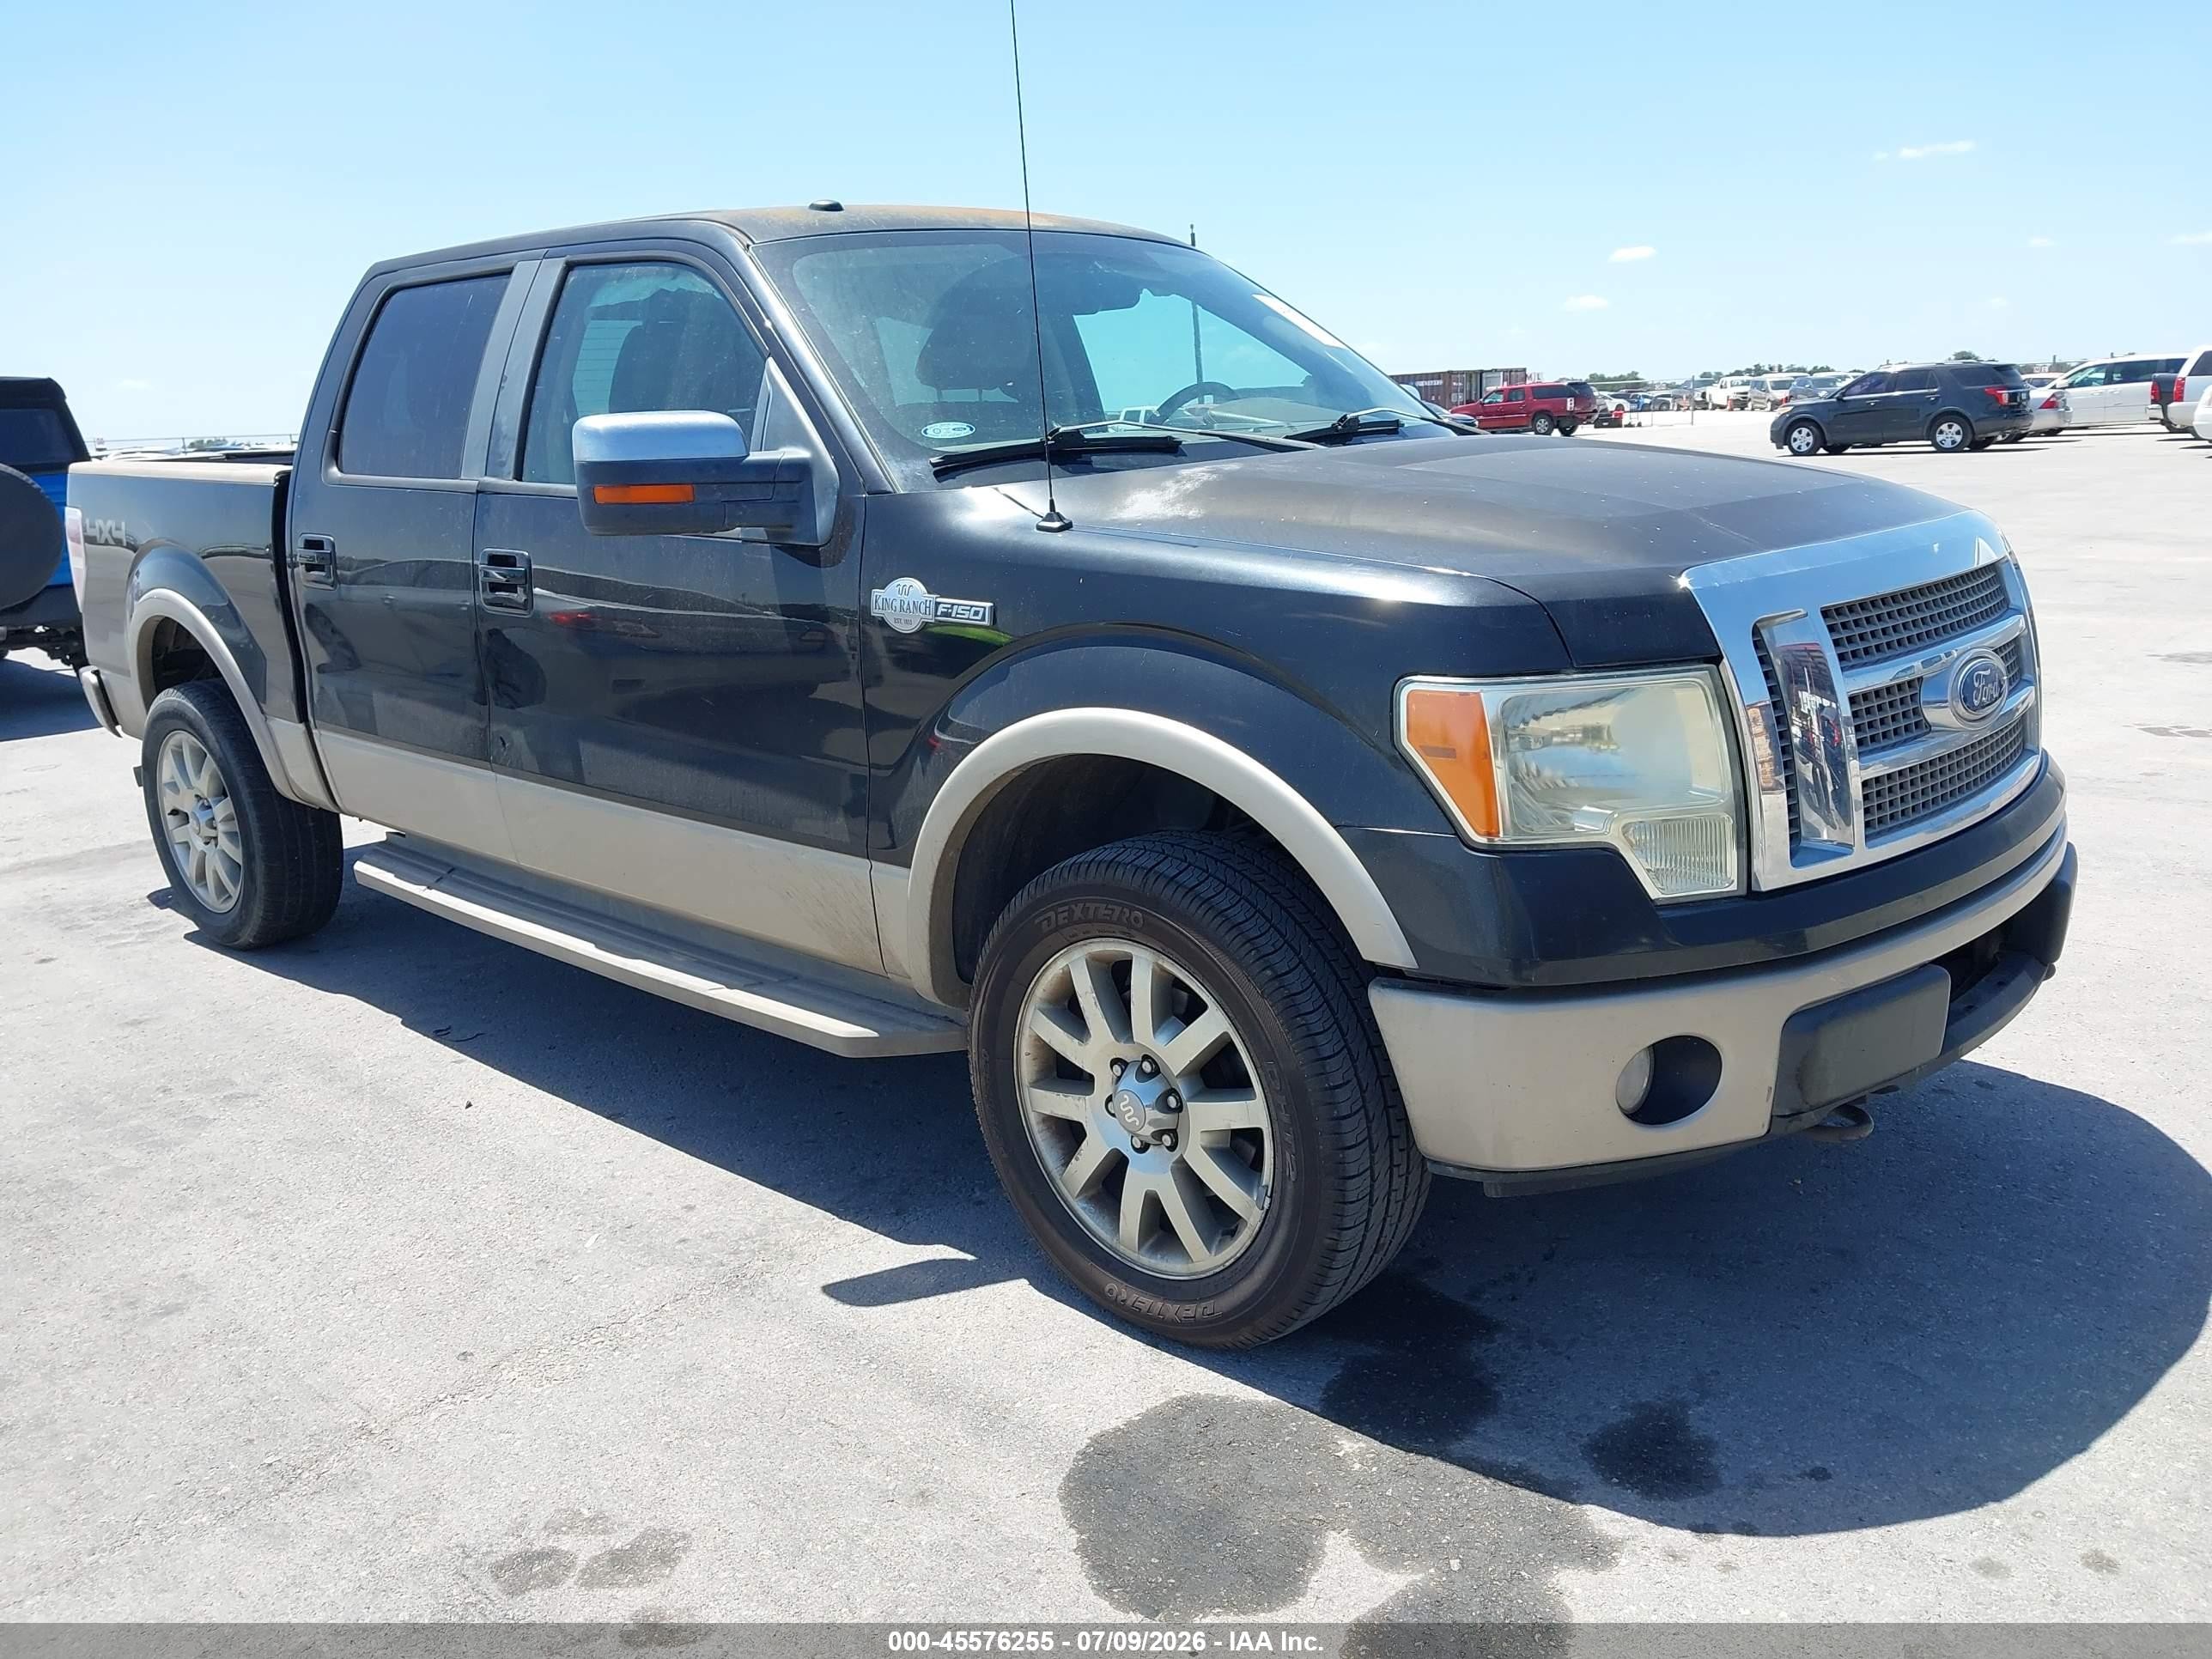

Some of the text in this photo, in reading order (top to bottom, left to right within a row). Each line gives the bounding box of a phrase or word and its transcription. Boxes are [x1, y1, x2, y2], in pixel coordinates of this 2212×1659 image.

[874, 594, 933, 616] KING RANCH
[937, 604, 985, 620] F-150
[1972, 668, 2002, 706] Ford
[1035, 902, 1144, 933] DEXTERO
[1104, 1283, 1223, 1323] DEXTERO
